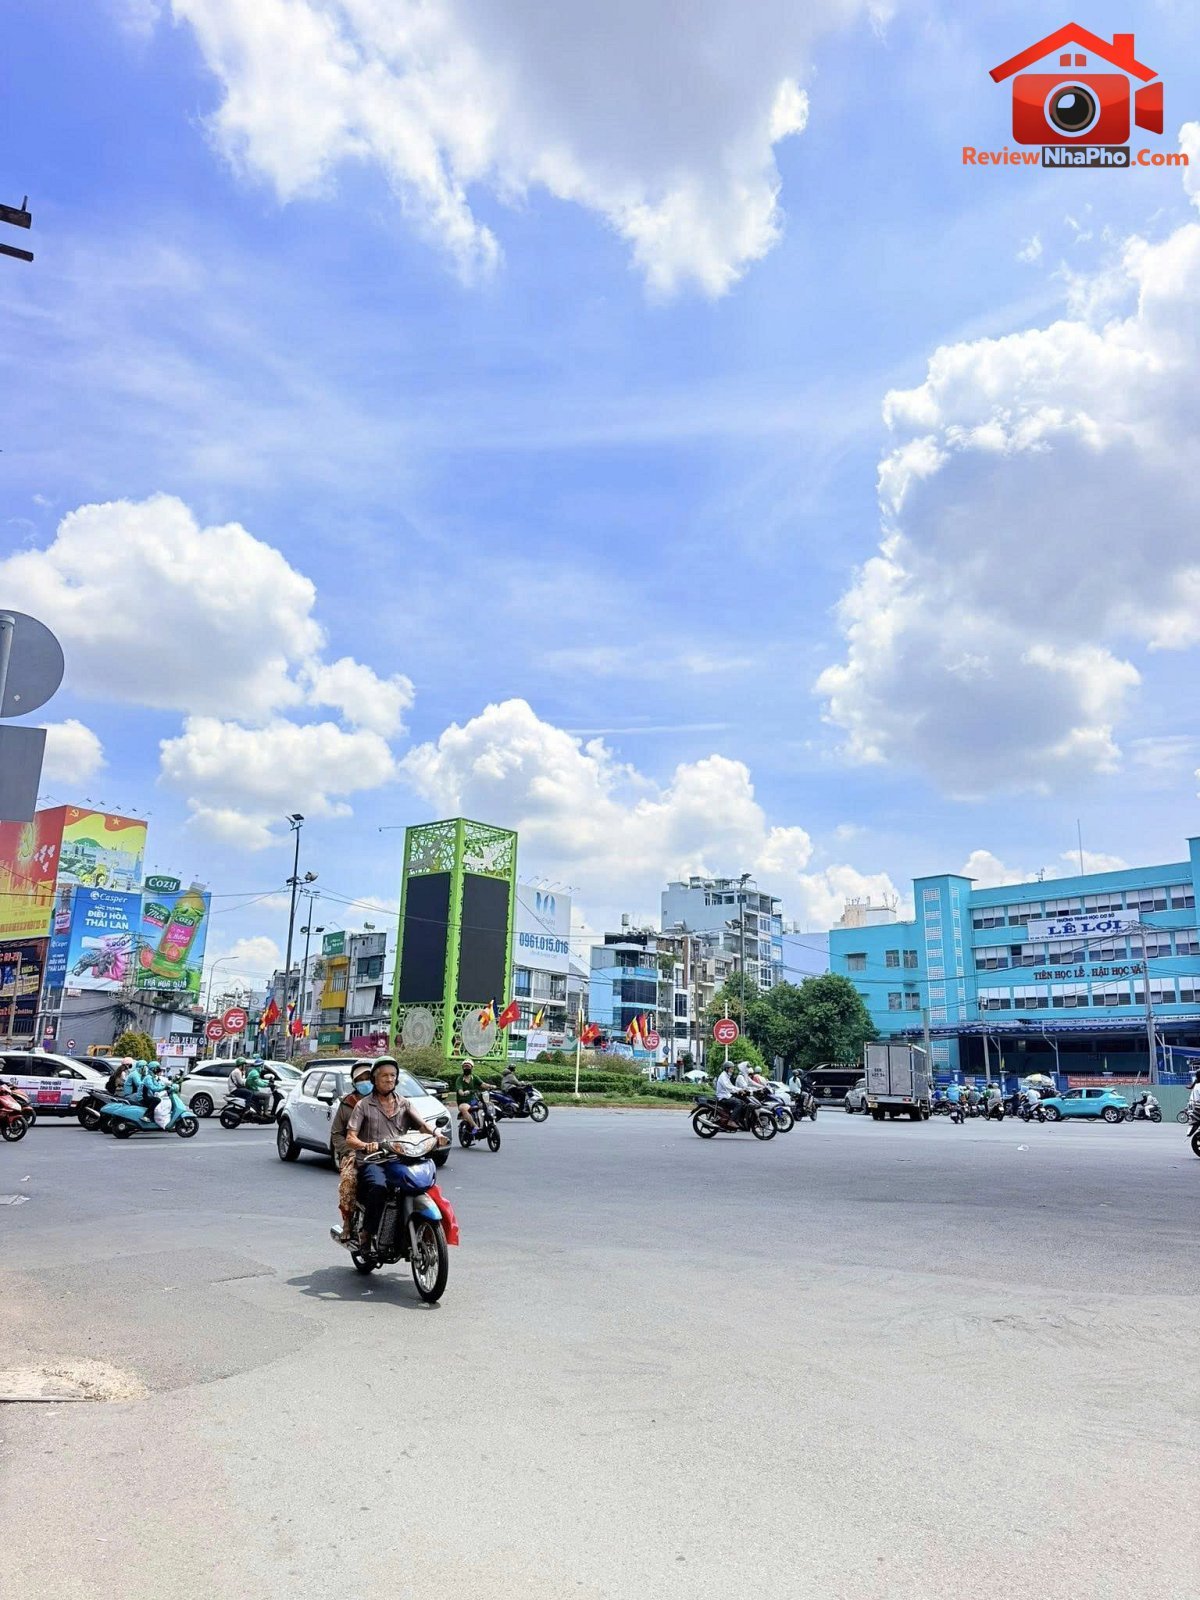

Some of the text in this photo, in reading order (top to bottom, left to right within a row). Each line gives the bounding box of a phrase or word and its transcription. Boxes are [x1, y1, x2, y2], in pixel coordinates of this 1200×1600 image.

[148, 877, 177, 892] Cozy
[100, 892, 128, 903] Casper
[110, 921, 129, 930] LAN
[1048, 920, 1122, 935] LÊ LỢI
[520, 932, 569, 954] 0961.015.016
[1054, 970, 1072, 980] HỌC
[1112, 966, 1130, 976] HỌC
[227, 1016, 244, 1028] 5G
[208, 1026, 222, 1036] 5G
[718, 1028, 735, 1039] 5G
